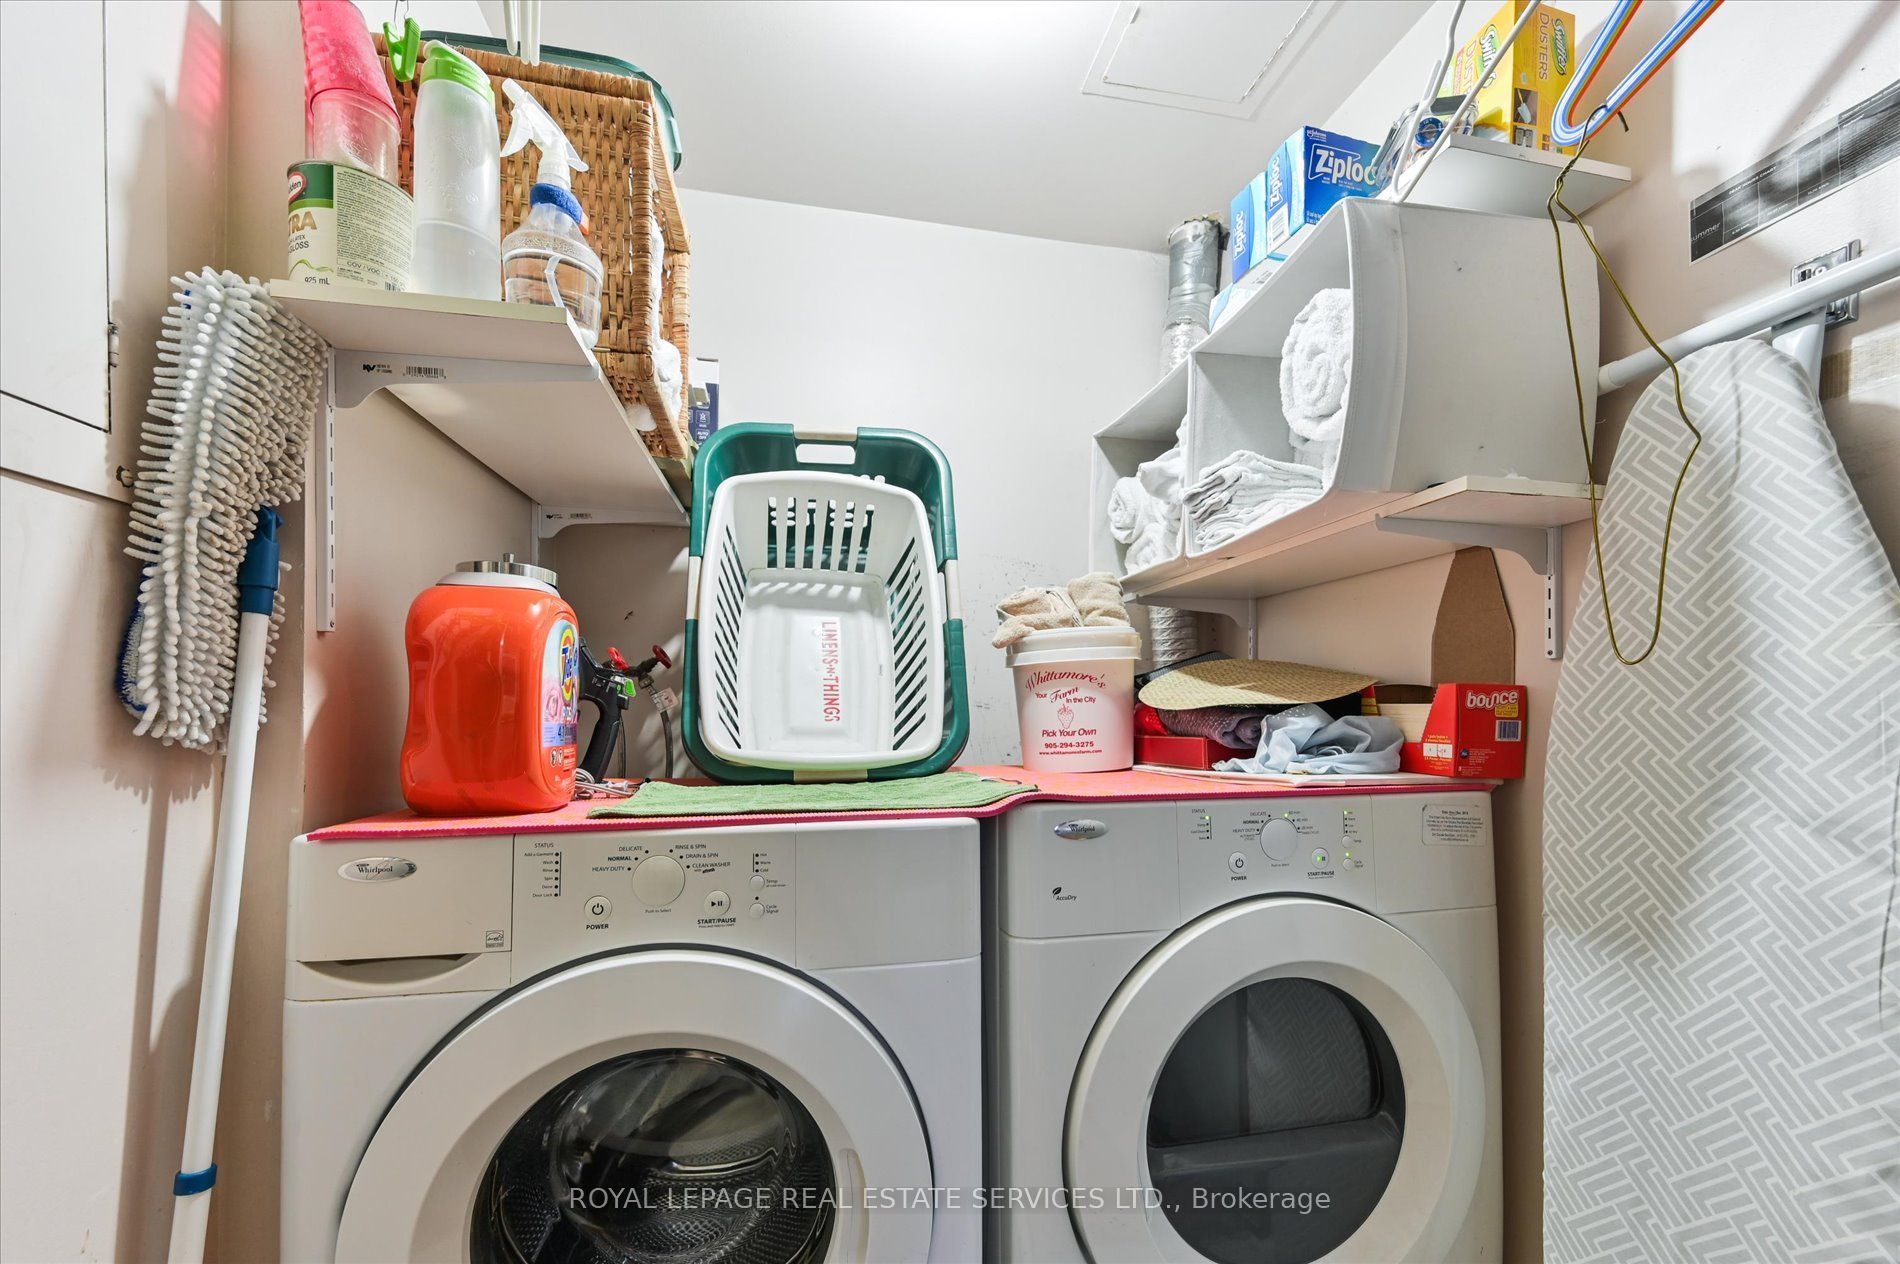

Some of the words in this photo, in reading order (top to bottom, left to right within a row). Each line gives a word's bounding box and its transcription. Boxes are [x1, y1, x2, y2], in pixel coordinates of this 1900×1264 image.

[1538, 12, 1550, 80] DUSTERS
[1551, 17, 1568, 76] Swiffer
[1315, 148, 1377, 186] Ziploc
[1759, 165, 1777, 178] CHART
[1269, 156, 1283, 208] Ziploc
[1233, 210, 1247, 260] Ziploc
[304, 276, 317, 284] 925
[1025, 670, 1106, 692] Whittamore's
[1050, 687, 1079, 703] Farm
[1084, 696, 1097, 704] City
[1466, 690, 1519, 709] bounce
[1041, 729, 1057, 738] Pick
[1059, 729, 1077, 737] Your
[1078, 728, 1097, 736] Own
[1044, 741, 1094, 749] 905-294-3275
[357, 866, 393, 874] Whirlpool
[697, 917, 736, 925] START/PAUSE
